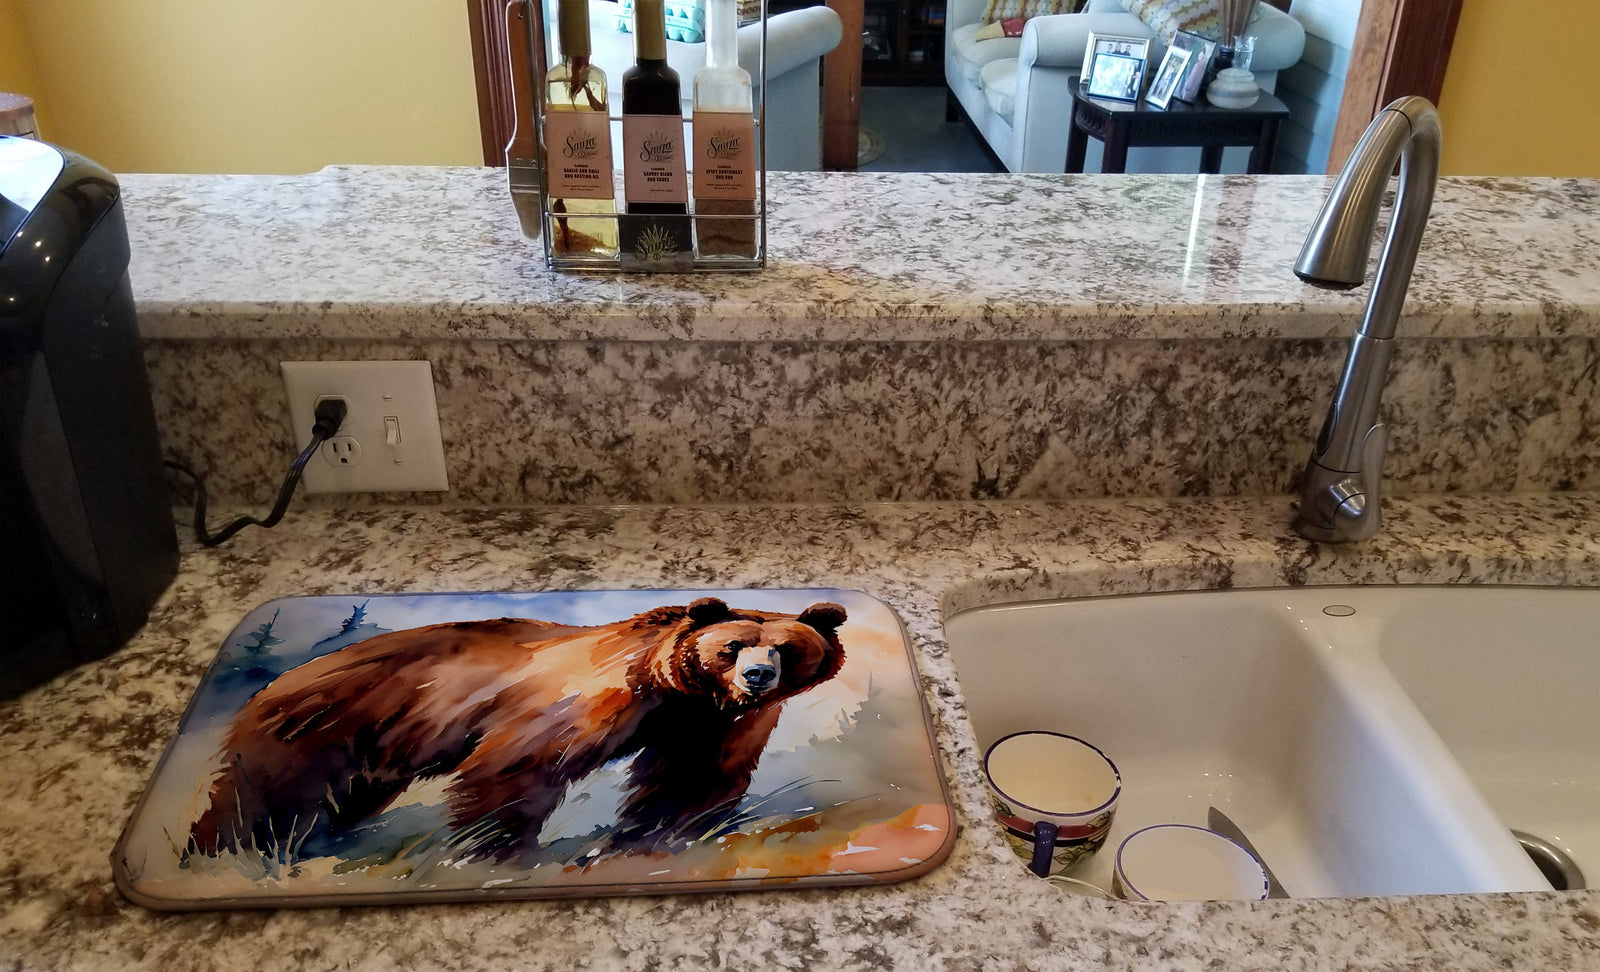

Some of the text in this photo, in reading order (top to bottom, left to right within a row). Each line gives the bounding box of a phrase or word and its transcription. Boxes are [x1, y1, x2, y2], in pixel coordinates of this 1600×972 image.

[562, 136, 597, 158] Sauza
[640, 140, 674, 162] Sauza
[706, 136, 740, 159] Sauza
